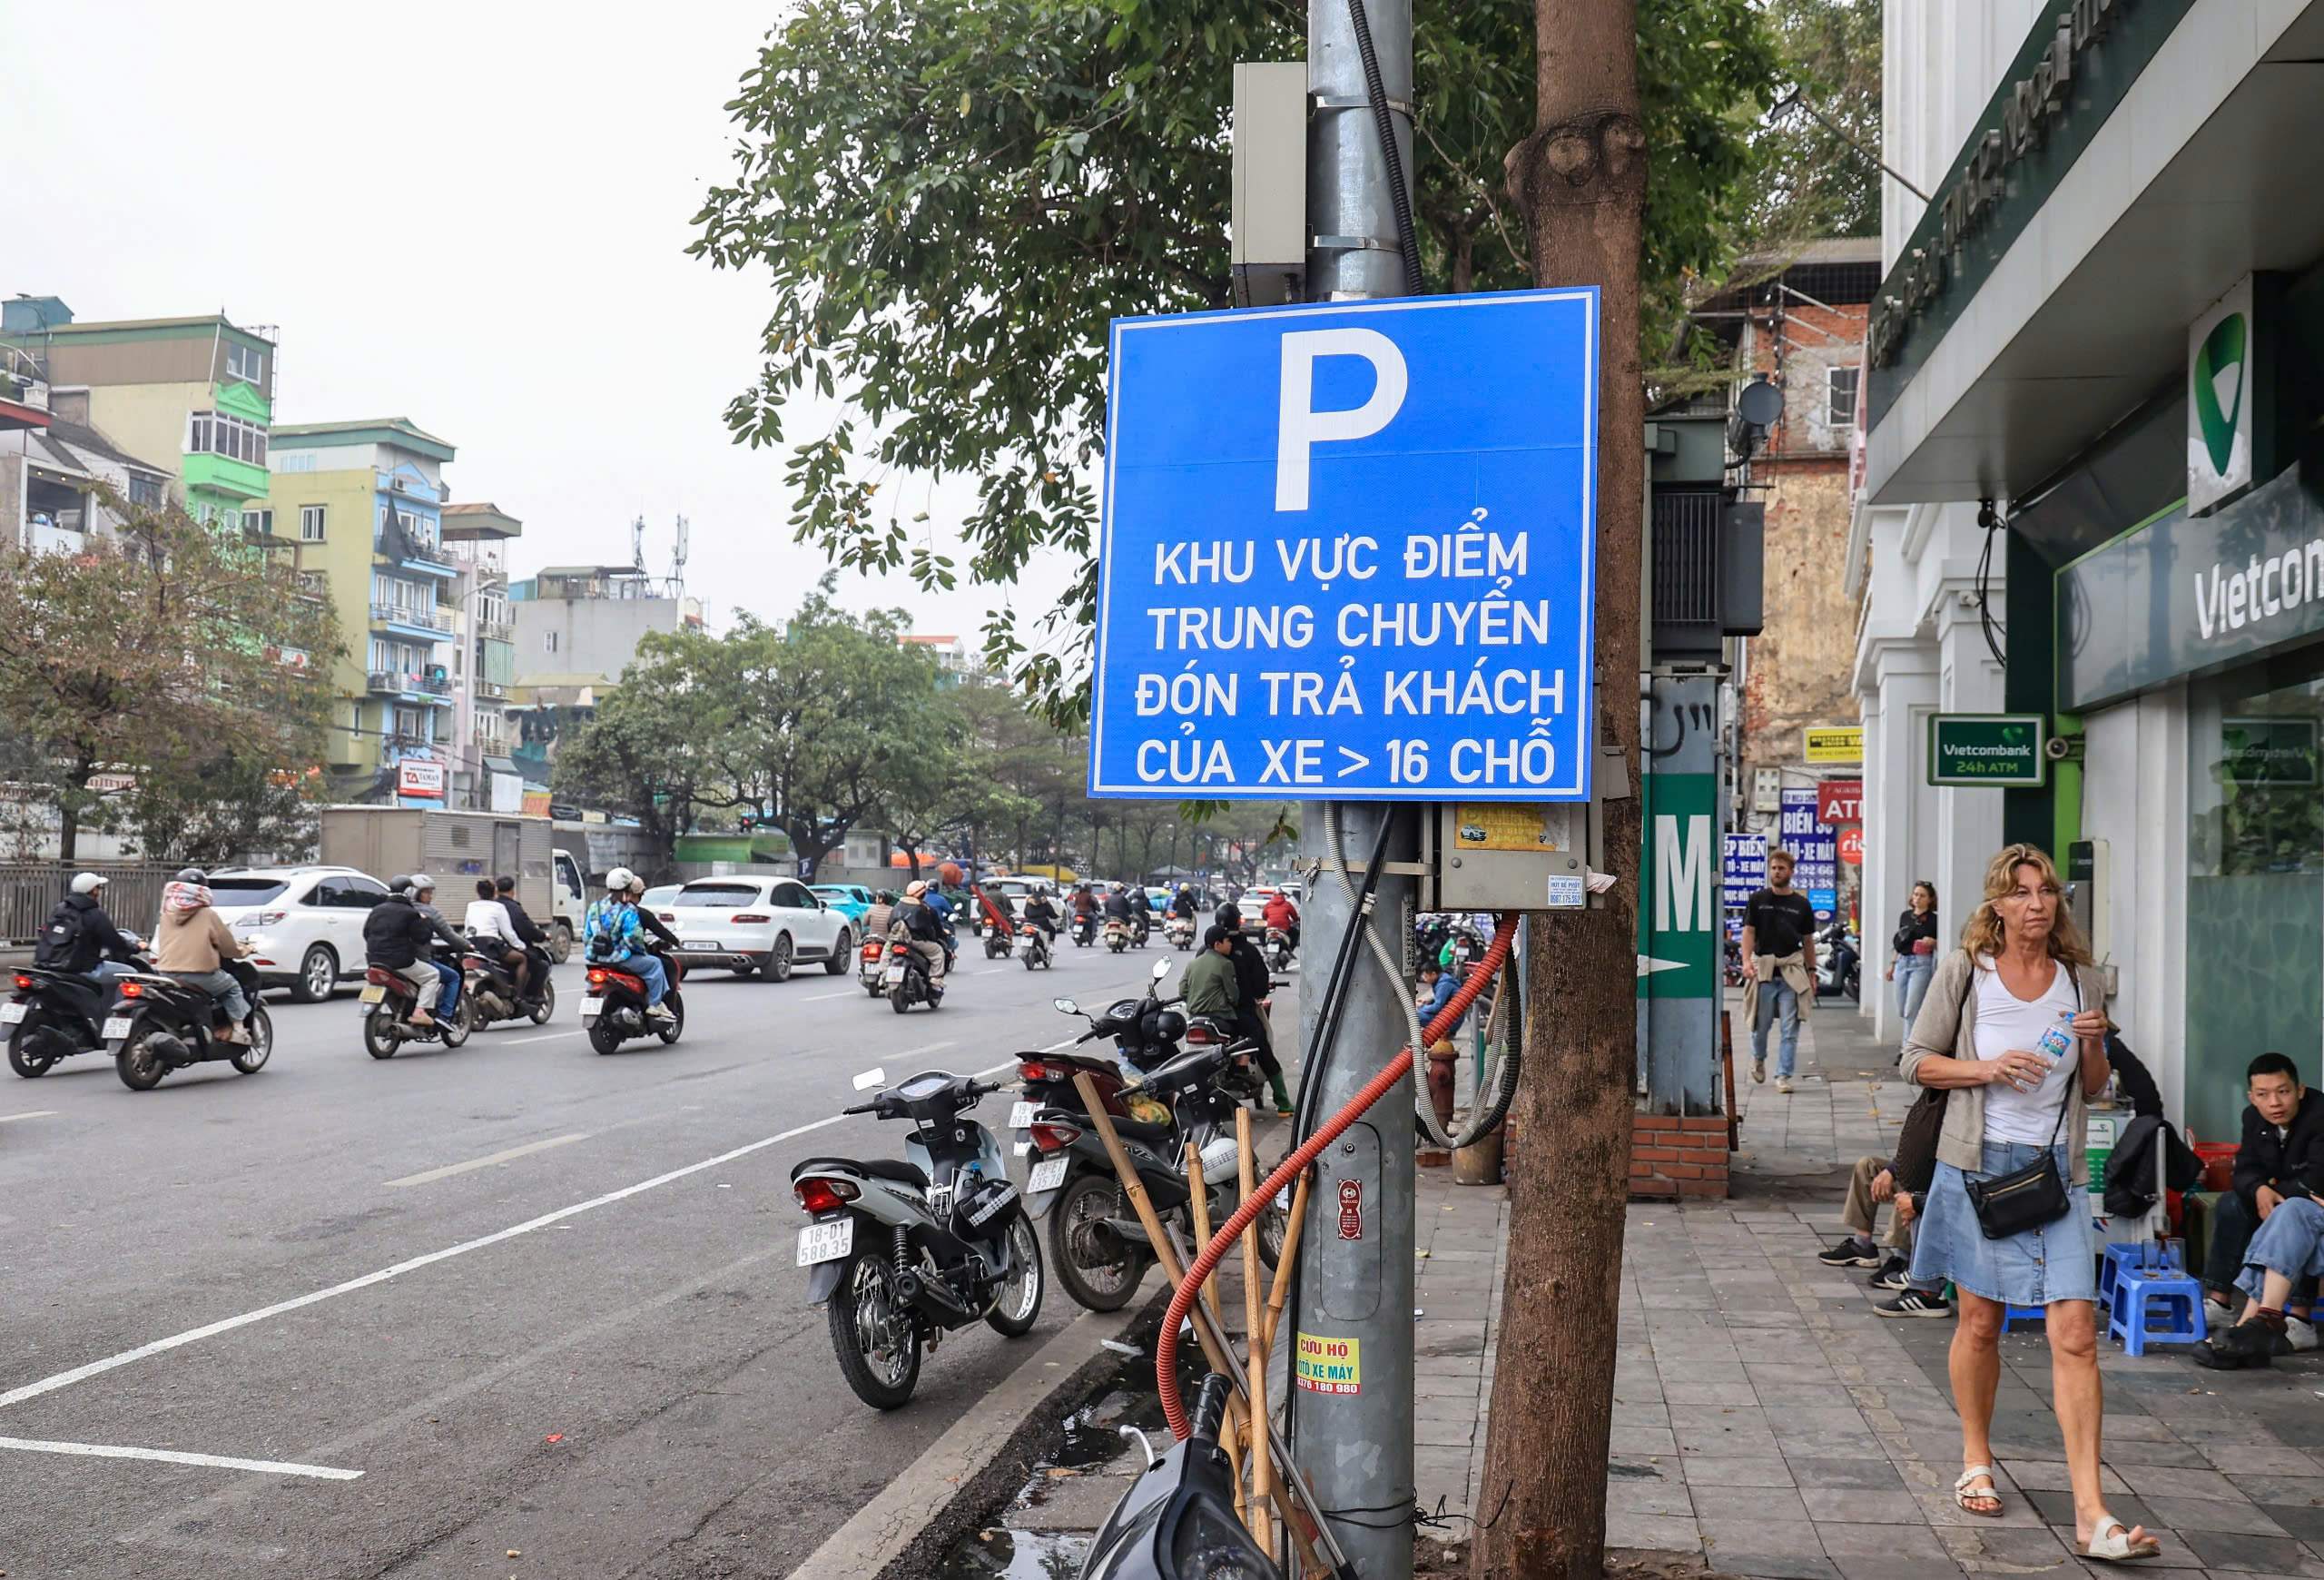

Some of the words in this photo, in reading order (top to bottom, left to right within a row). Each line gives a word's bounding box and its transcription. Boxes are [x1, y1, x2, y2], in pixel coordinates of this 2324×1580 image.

[1275, 328, 1408, 512] P
[1155, 541, 1254, 586] KHU
[1276, 533, 1378, 590] VỰC
[1403, 508, 1527, 578] ĐIỂM
[1147, 605, 1314, 650] TRUNG
[1337, 576, 1549, 647] CHUYỂN
[1135, 660, 1237, 716] ĐÓN
[1260, 655, 1363, 716] TRẢ
[1384, 657, 1563, 716] KHÁCH
[1137, 722, 1236, 783] CỦA
[1259, 740, 1324, 784] XE
[1386, 741, 1428, 783] 16
[1450, 718, 1555, 783] CHỖ
[1944, 745, 2031, 755] Vietcombank
[1956, 761, 1985, 773] 24h
[1988, 763, 2018, 773] ATM
[809, 1222, 843, 1244] 18-D1
[801, 1238, 849, 1263] 588.35
[1301, 1338, 1322, 1355] CỨU
[1327, 1342, 1348, 1359] HỘ
[1313, 1364, 1324, 1378] XE
[1328, 1364, 1353, 1379] MÁY
[1315, 1382, 1333, 1392] 180
[1336, 1384, 1357, 1394] 980
